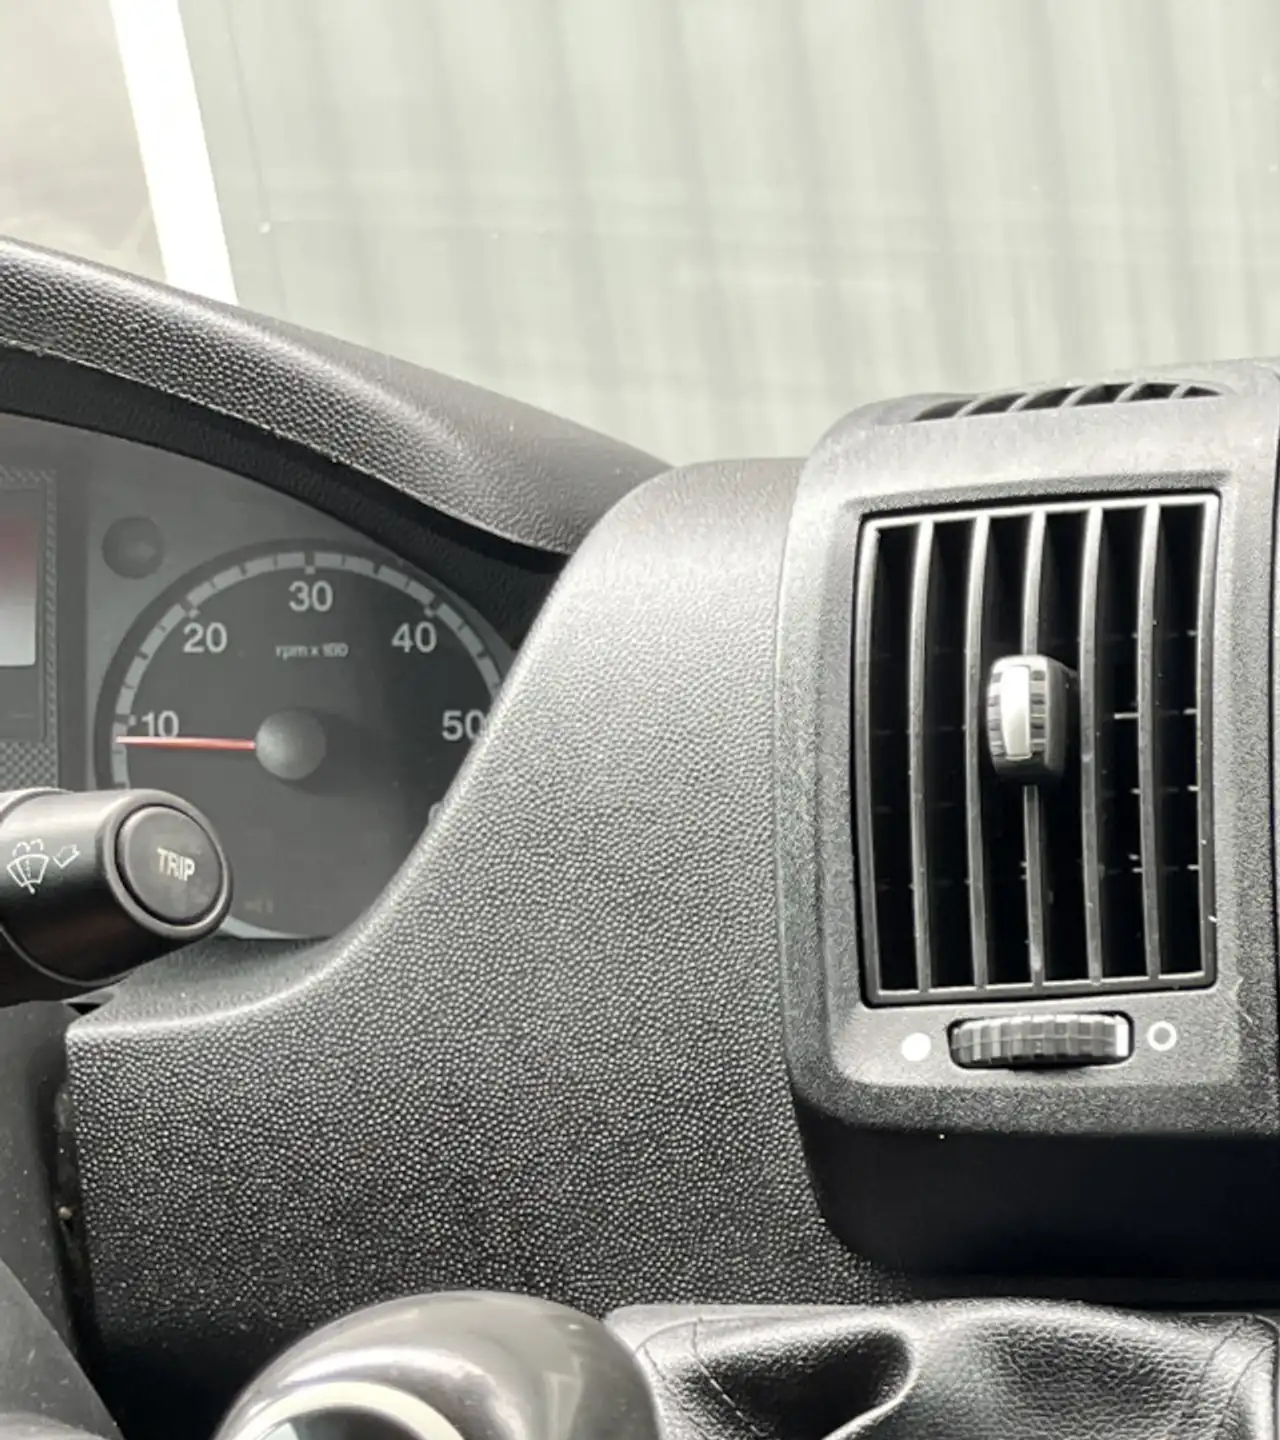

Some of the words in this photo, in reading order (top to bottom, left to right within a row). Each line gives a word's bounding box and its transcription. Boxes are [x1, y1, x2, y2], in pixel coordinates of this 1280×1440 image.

[288, 580, 333, 612] 30
[183, 622, 228, 653] 20
[276, 645, 308, 660] rpm
[391, 621, 437, 653] 40
[140, 708, 182, 740] 10
[442, 708, 487, 741] 50
[157, 847, 196, 882] TRIP
